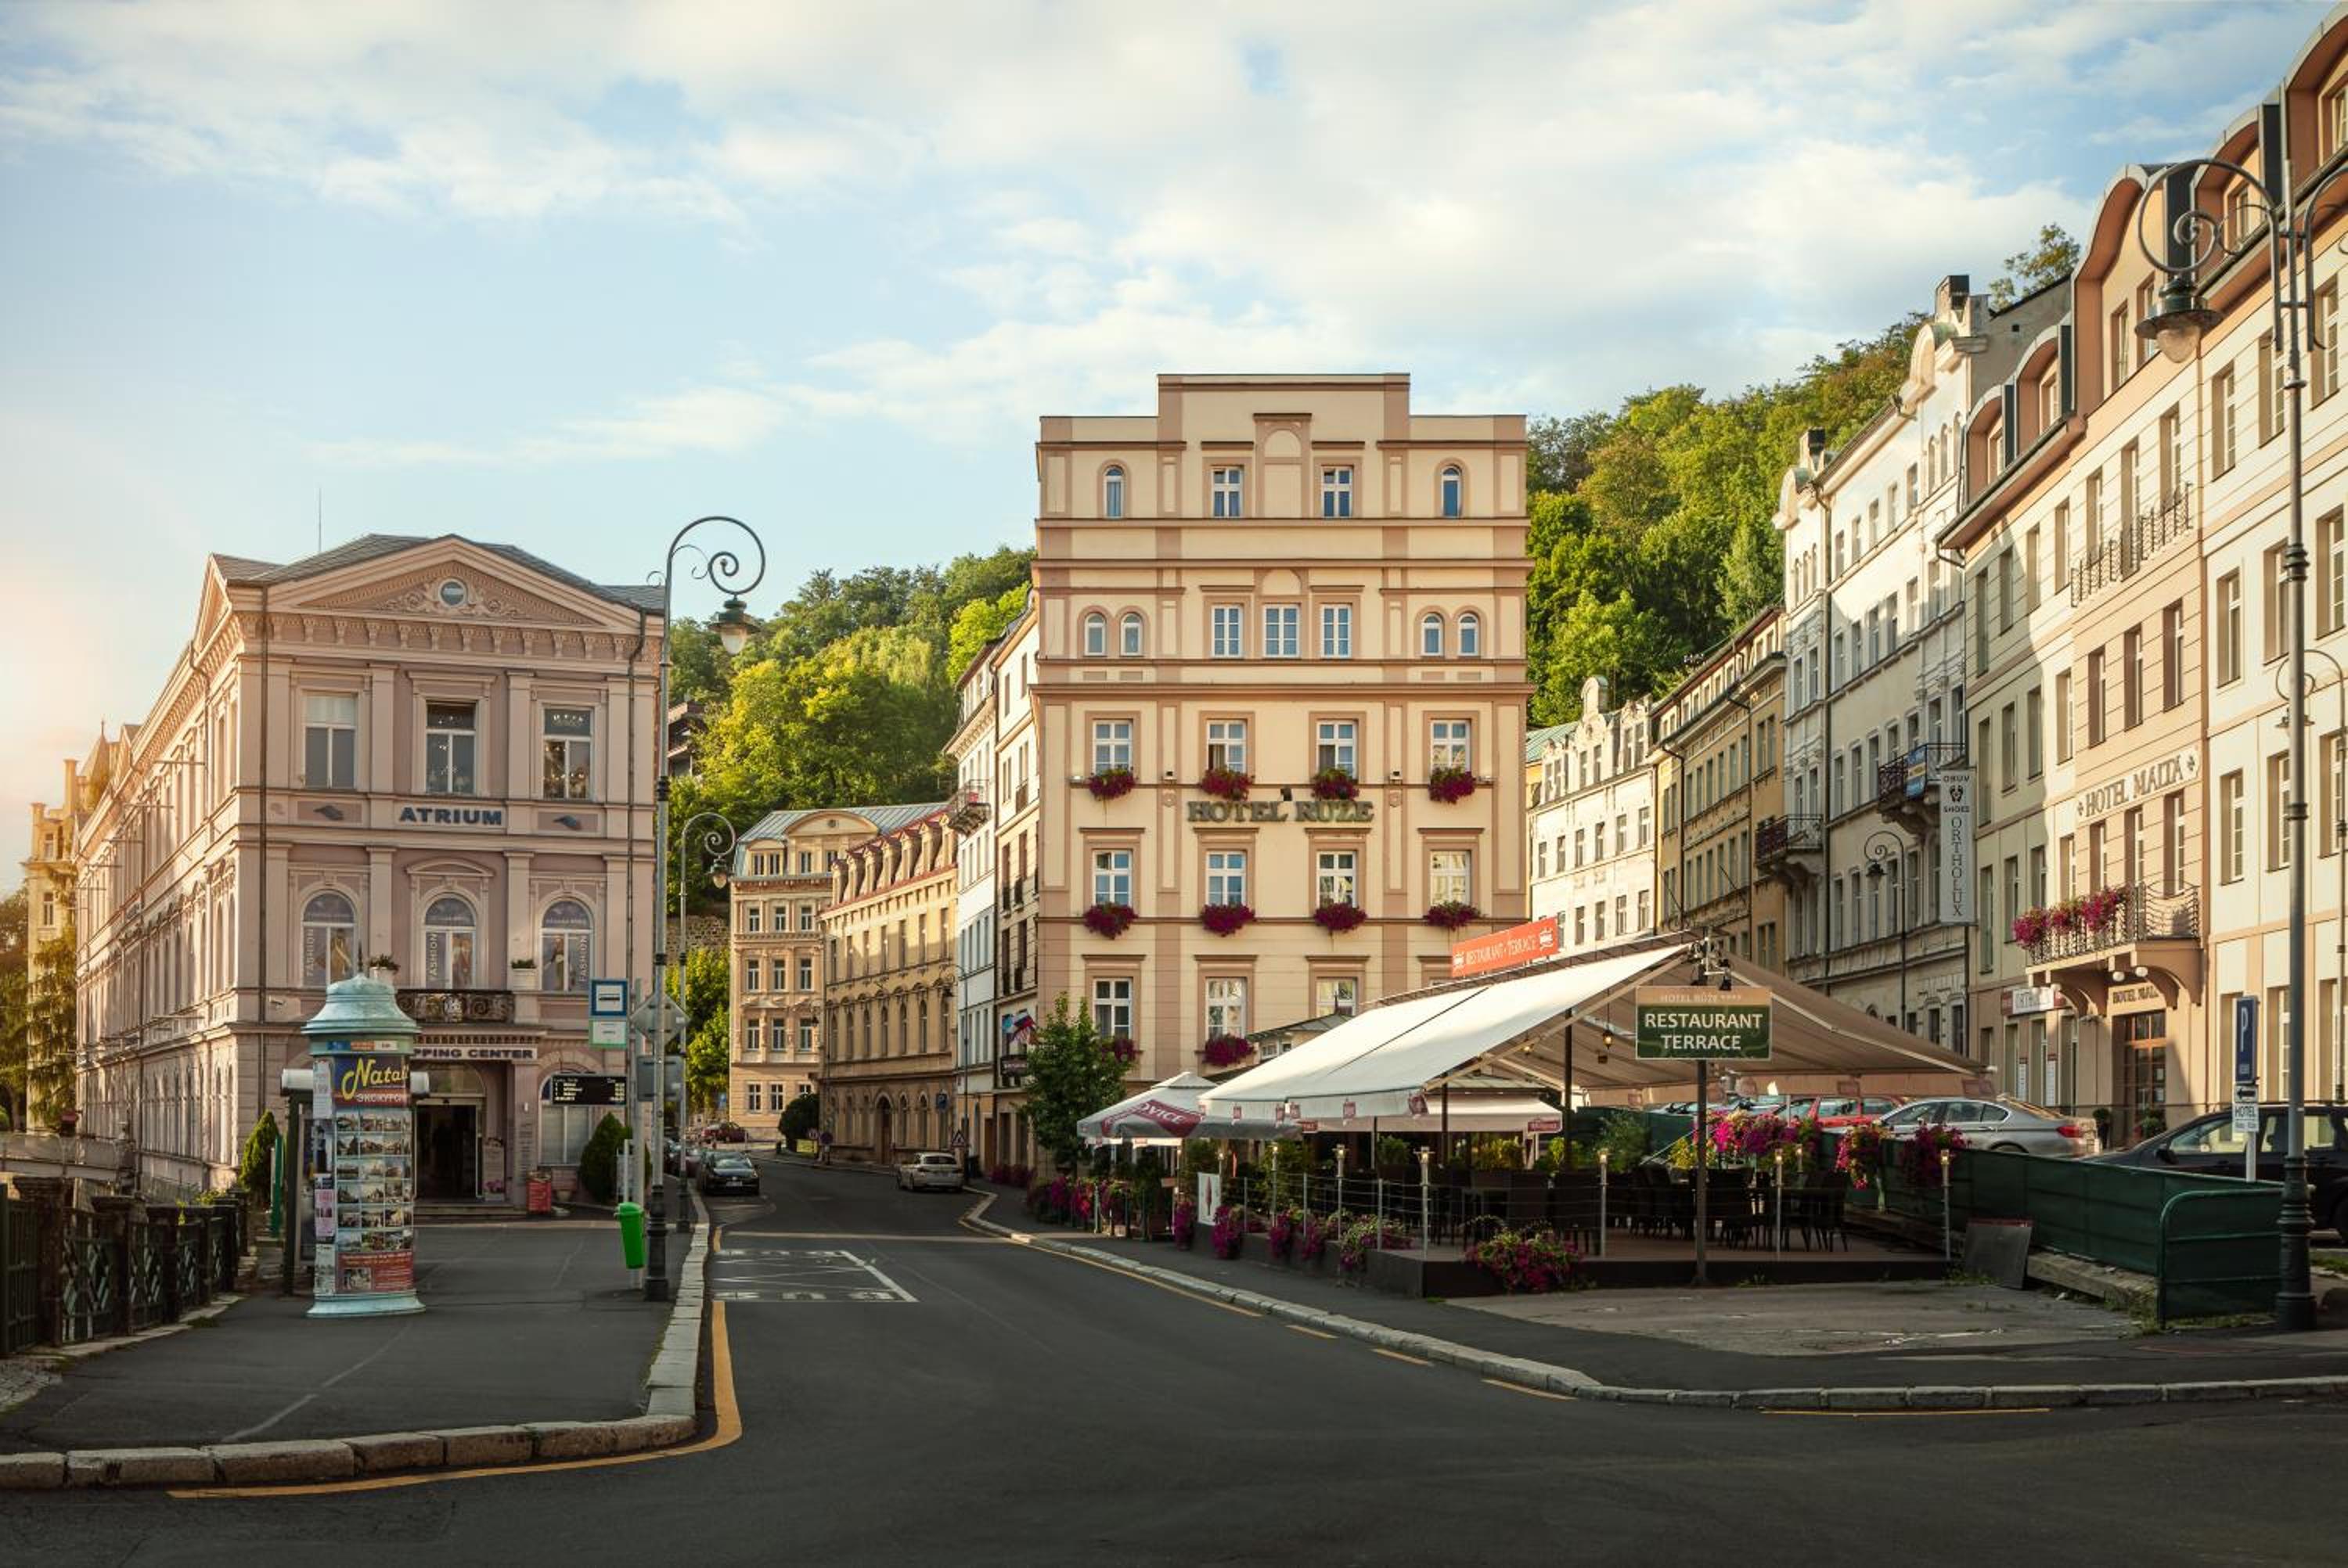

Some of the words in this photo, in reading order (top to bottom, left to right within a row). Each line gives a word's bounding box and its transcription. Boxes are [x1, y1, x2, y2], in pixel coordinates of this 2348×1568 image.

[2085, 779, 2130, 818] HOTEL
[2134, 753, 2184, 799] MALTA
[399, 807, 502, 825] ATRIUM
[1187, 800, 1289, 822] HOTEL
[1951, 816, 1963, 917] ORTHOLUX
[1660, 994, 1691, 1002] HOTEL
[2112, 988, 2136, 1004] HOTEL
[1645, 1013, 1763, 1029] RESTAURANT
[2241, 1006, 2249, 1052] P
[1661, 1035, 1741, 1050] TERRACE
[468, 1049, 534, 1059] CENTER
